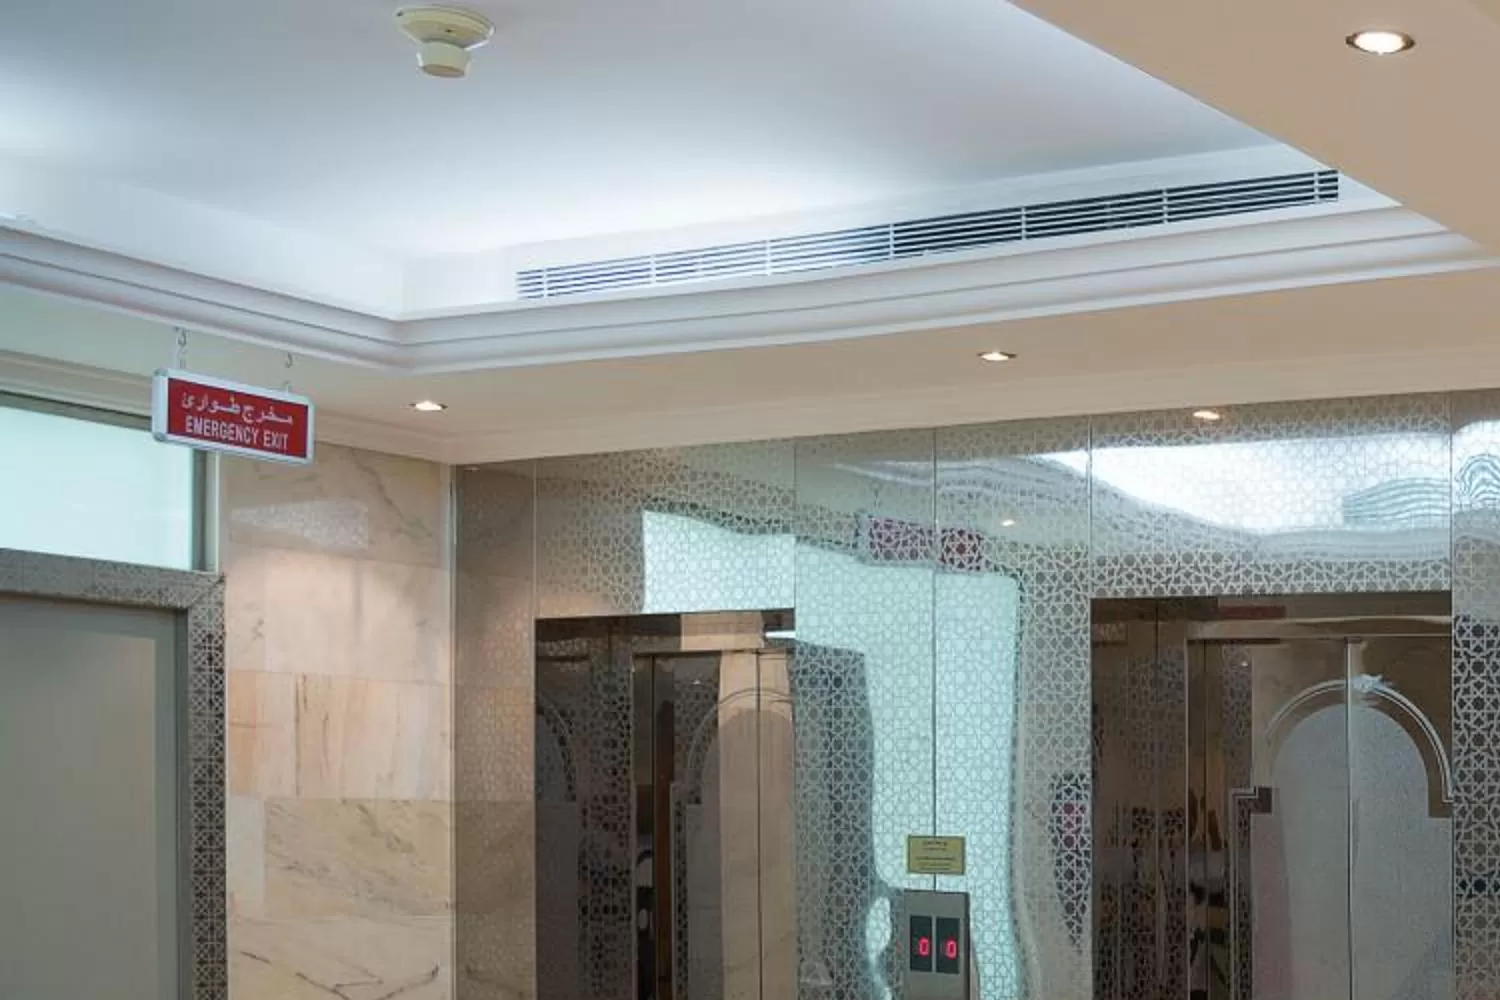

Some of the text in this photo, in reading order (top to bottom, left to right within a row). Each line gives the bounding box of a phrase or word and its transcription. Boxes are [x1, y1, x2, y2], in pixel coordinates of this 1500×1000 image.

[242, 405, 293, 425] مخرج
[185, 415, 289, 452] EMERGENCY EXIT
